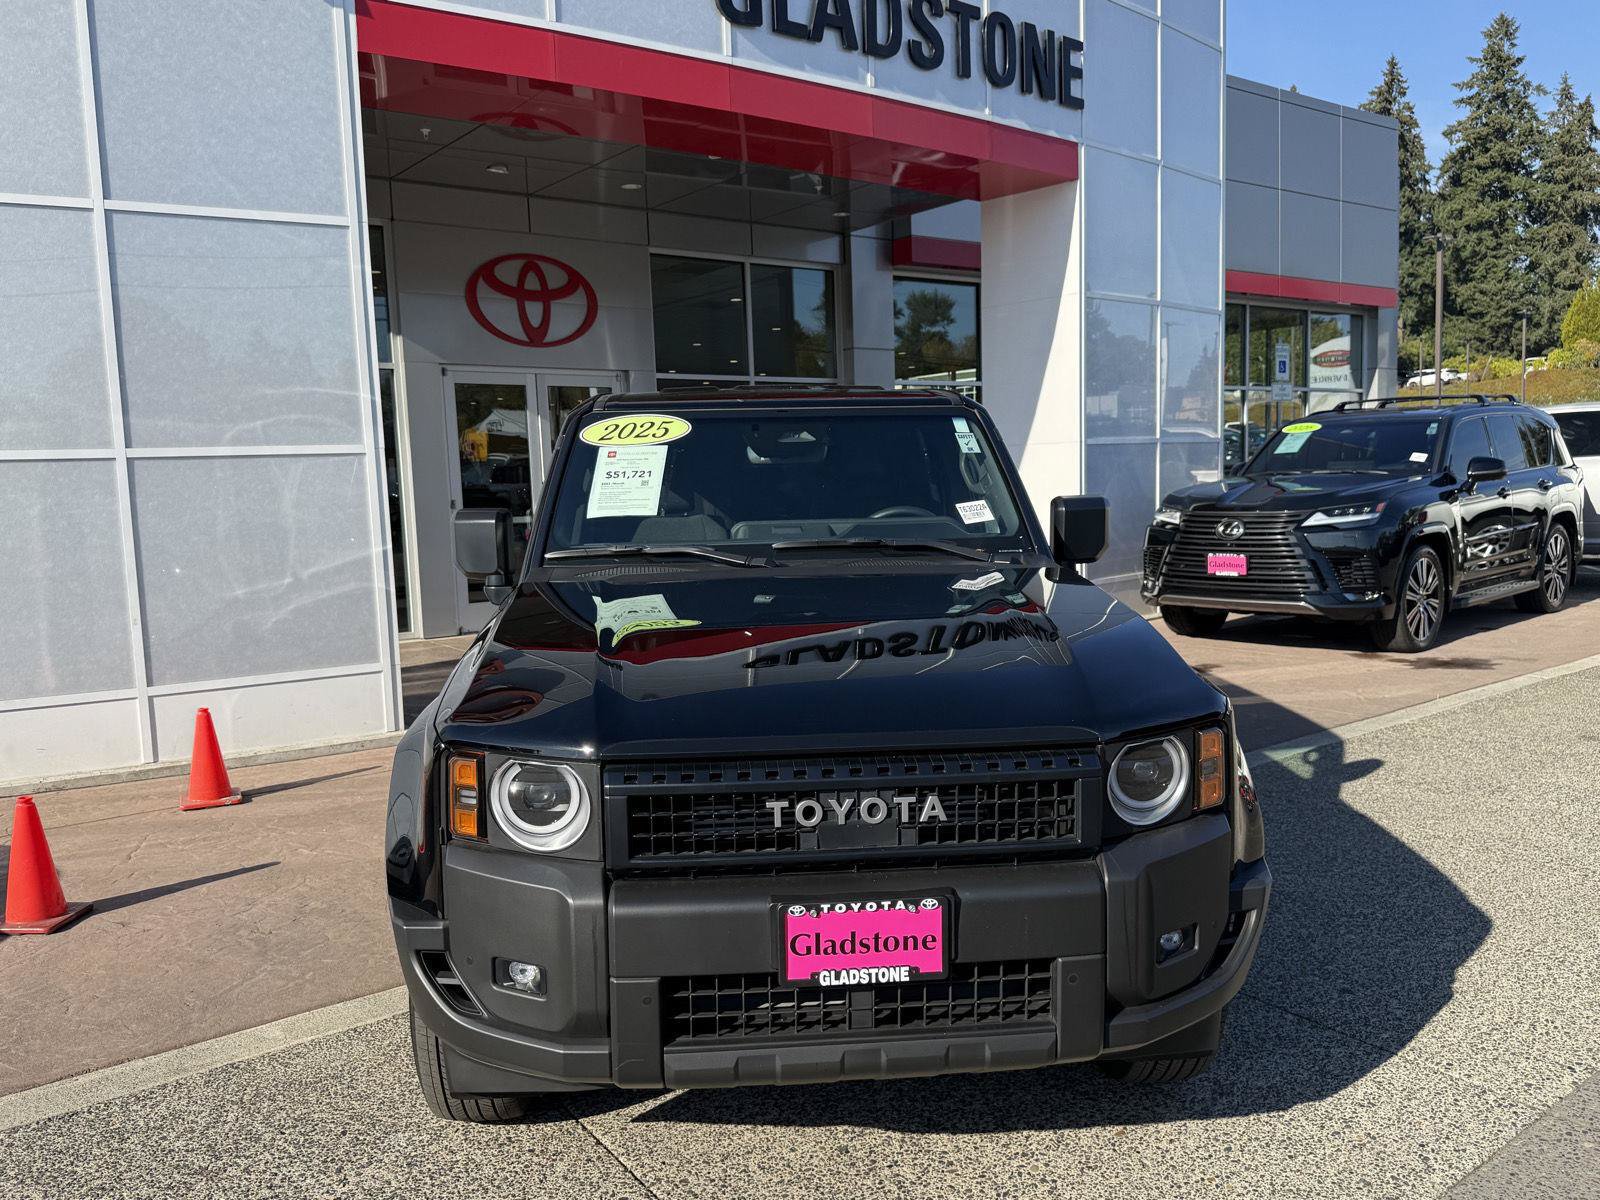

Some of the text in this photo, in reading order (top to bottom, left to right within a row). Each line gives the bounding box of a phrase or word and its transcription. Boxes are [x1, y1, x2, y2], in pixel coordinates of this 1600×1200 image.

[598, 420, 674, 441] 2025
[605, 470, 653, 480] $51,721
[1209, 561, 1245, 569] Gladstone
[766, 795, 948, 828] TOYOTA
[820, 900, 906, 914] TOYOTA
[790, 931, 938, 956] Gladstone
[818, 966, 910, 987] GLADSTONE
